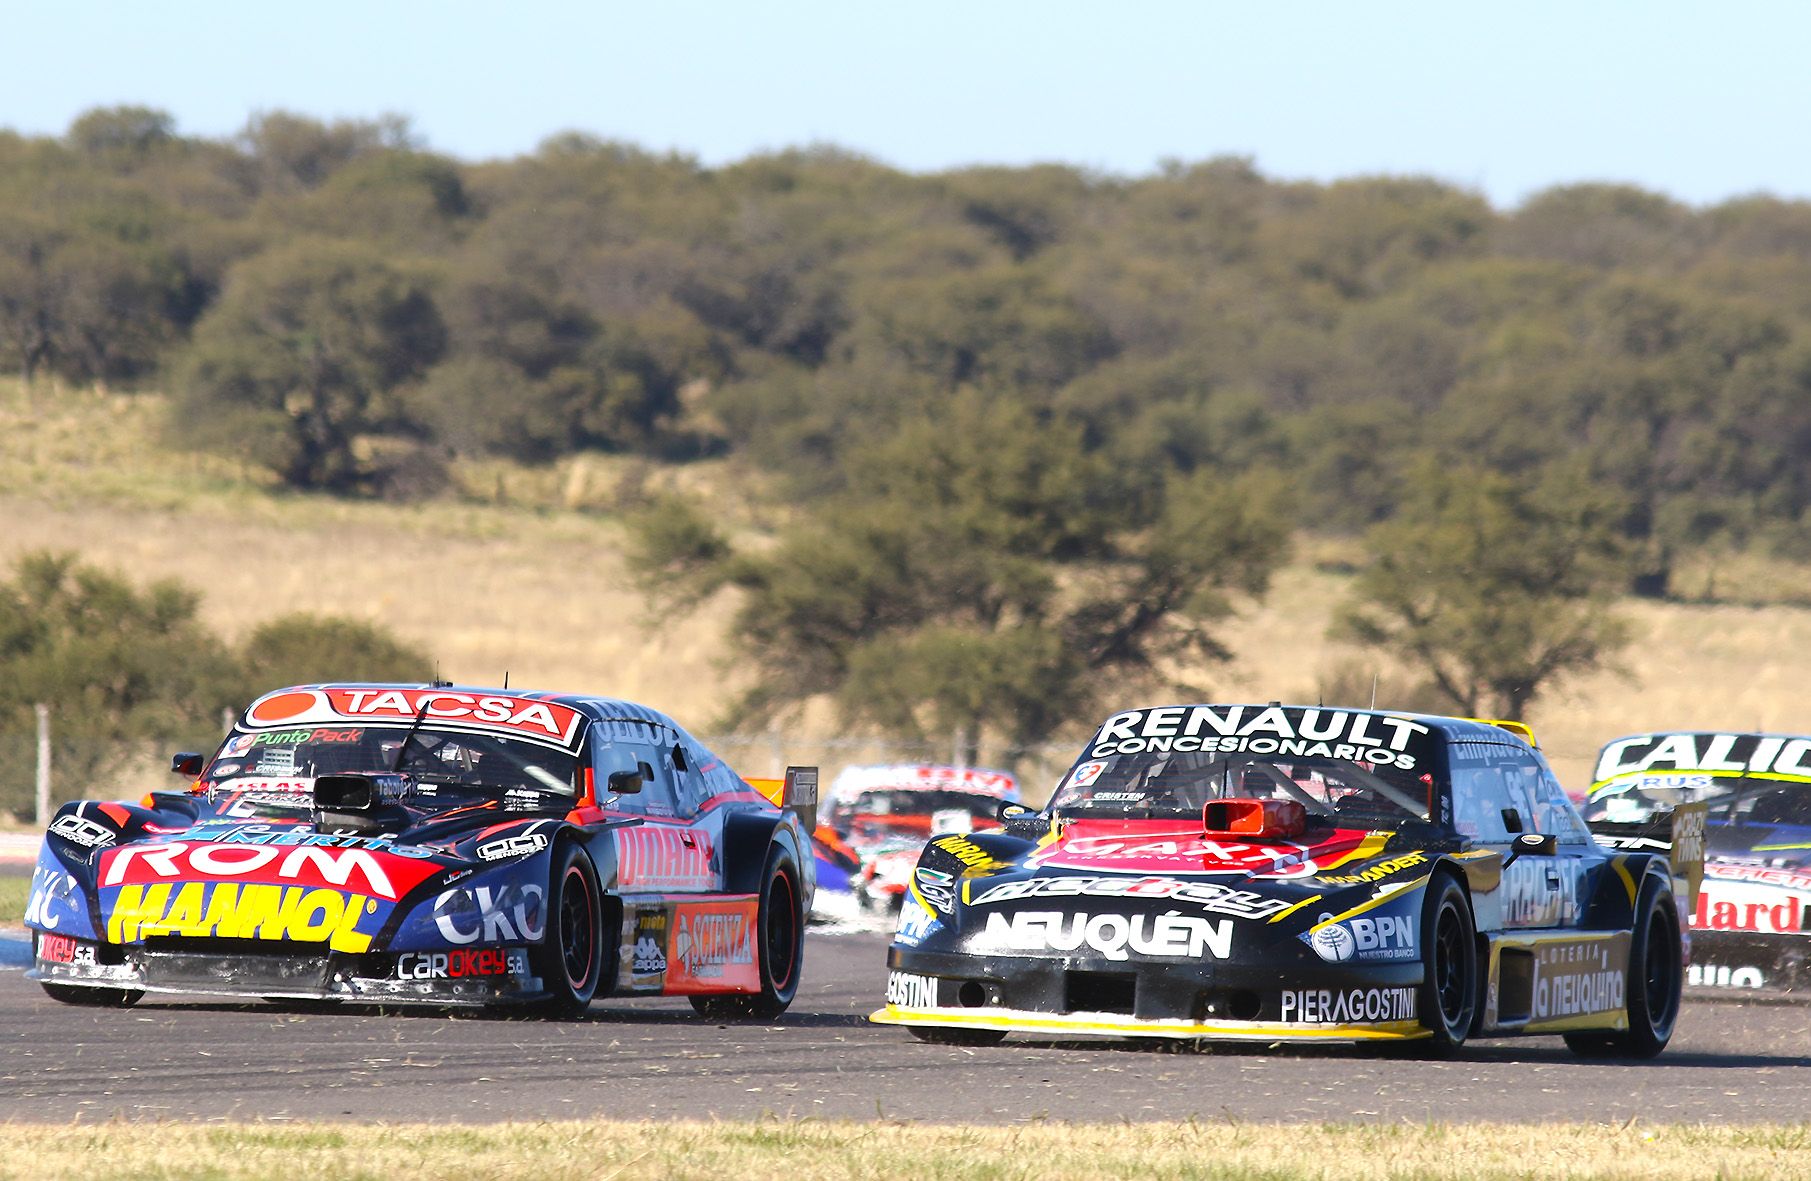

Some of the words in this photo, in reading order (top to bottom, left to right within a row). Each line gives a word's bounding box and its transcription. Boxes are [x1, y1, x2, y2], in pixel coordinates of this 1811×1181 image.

[343, 690, 561, 735] TACSA
[1096, 705, 1430, 752] RENAULT
[251, 728, 364, 747] PuntoPack
[1091, 736, 1417, 770] CONCESIONARIOS
[1093, 791, 1146, 801] CRISTEM
[104, 842, 397, 900] ROM
[107, 882, 374, 954] MANNOL
[980, 908, 1236, 962] NEUQUÉN
[1351, 915, 1414, 951] BPN
[691, 911, 753, 966] SCIENZA
[1541, 943, 1600, 965] LOTERIA
[1280, 987, 1415, 1023] PIERAGOSTINI
